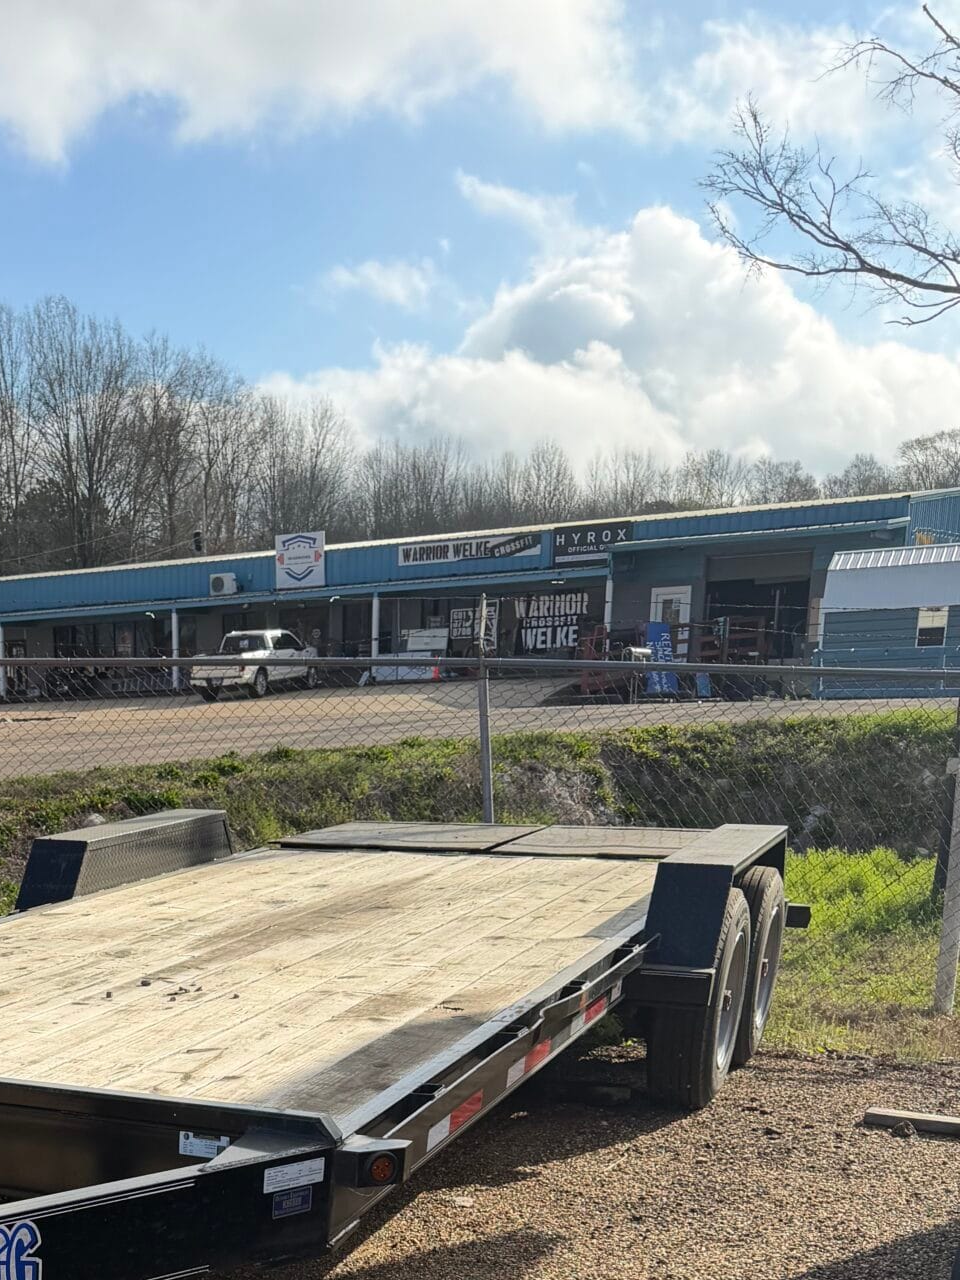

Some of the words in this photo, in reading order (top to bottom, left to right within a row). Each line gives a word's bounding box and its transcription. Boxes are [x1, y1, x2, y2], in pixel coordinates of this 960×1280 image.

[556, 529, 627, 546] HYROX
[402, 542, 449, 563] WARRIOR
[453, 540, 490, 559] WELKE
[494, 535, 533, 558] CROSSFIT
[568, 544, 598, 553] OFFICIAL
[514, 592, 589, 619] WARRIOR
[523, 615, 578, 627] CROSSFIT
[521, 625, 579, 650] WELKE
